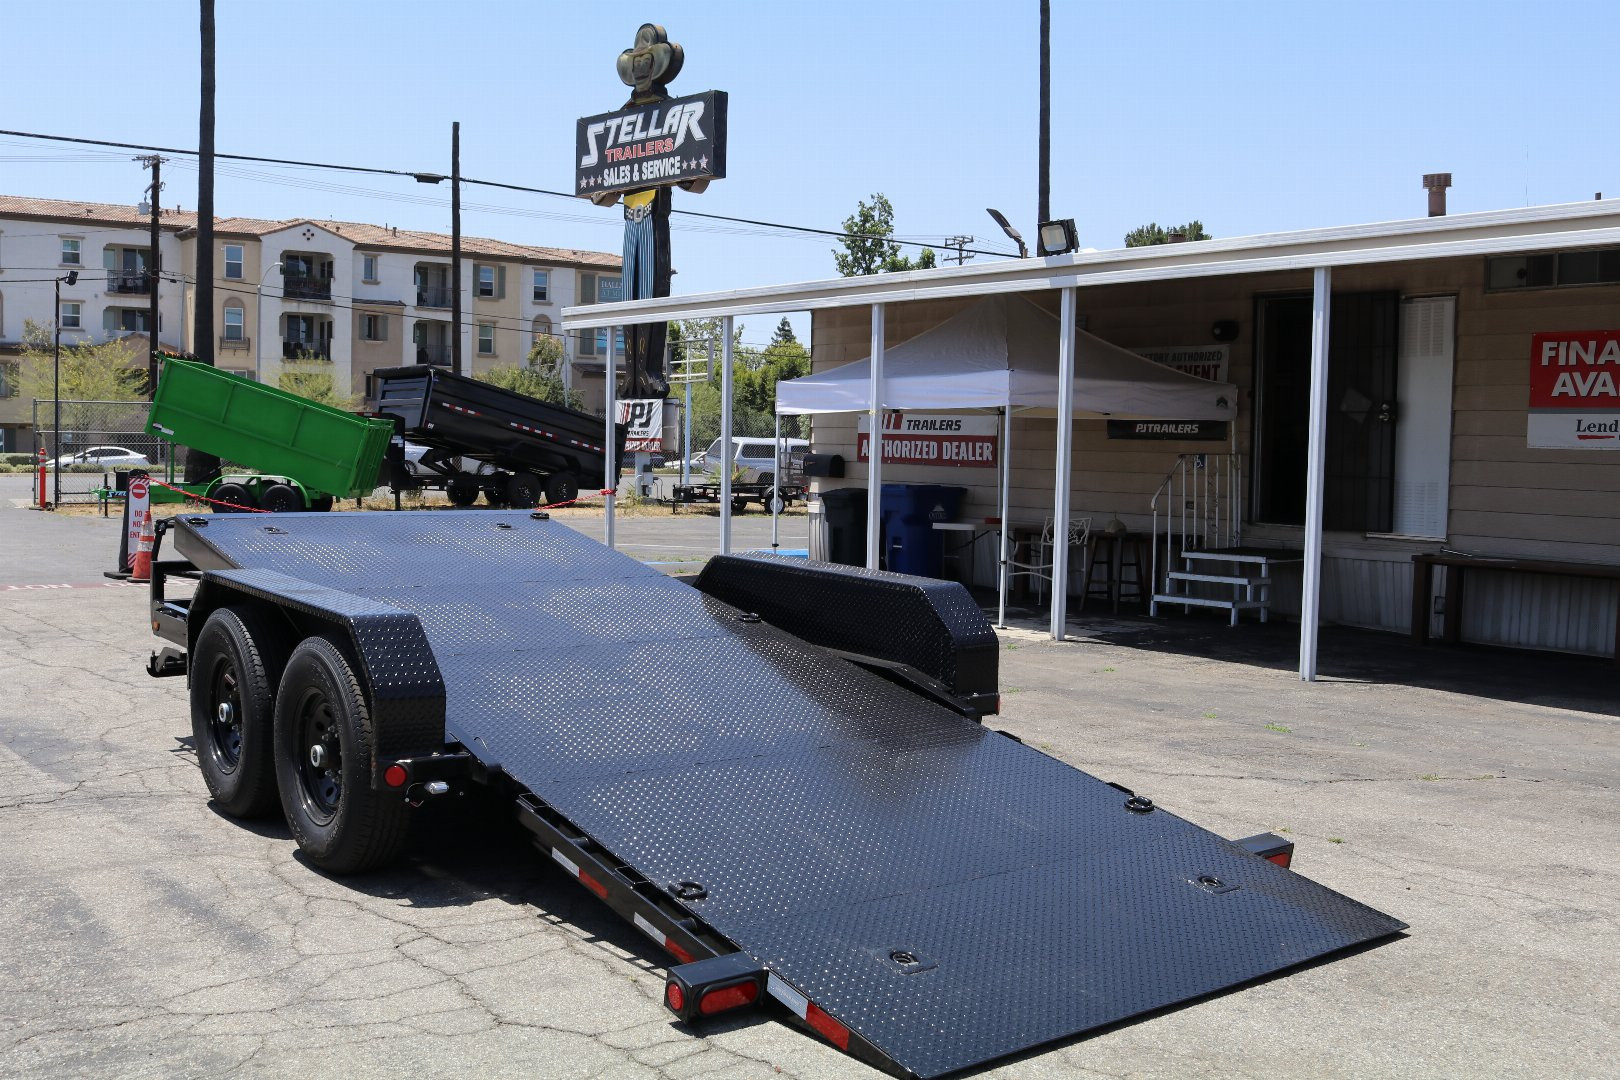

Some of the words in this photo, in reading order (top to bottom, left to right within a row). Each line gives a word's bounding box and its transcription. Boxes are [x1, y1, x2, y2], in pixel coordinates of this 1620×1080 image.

[580, 101, 707, 168] STELLAR
[605, 138, 674, 162] TRAILERS
[603, 165, 630, 187] SALES
[632, 165, 640, 181] &
[641, 156, 681, 179] SERVICE
[1171, 351, 1222, 362] AUTHORIZED
[1541, 340, 1620, 366] FINA
[1551, 371, 1620, 397] AVA
[628, 402, 654, 428] PJ
[907, 419, 962, 431] TRAILERS
[1576, 419, 1619, 433] Lend
[861, 439, 938, 460] AHORIZED
[942, 441, 993, 461] DEALER
[132, 520, 143, 528] NO
[134, 510, 143, 518] DO
[129, 531, 140, 539] ENT
